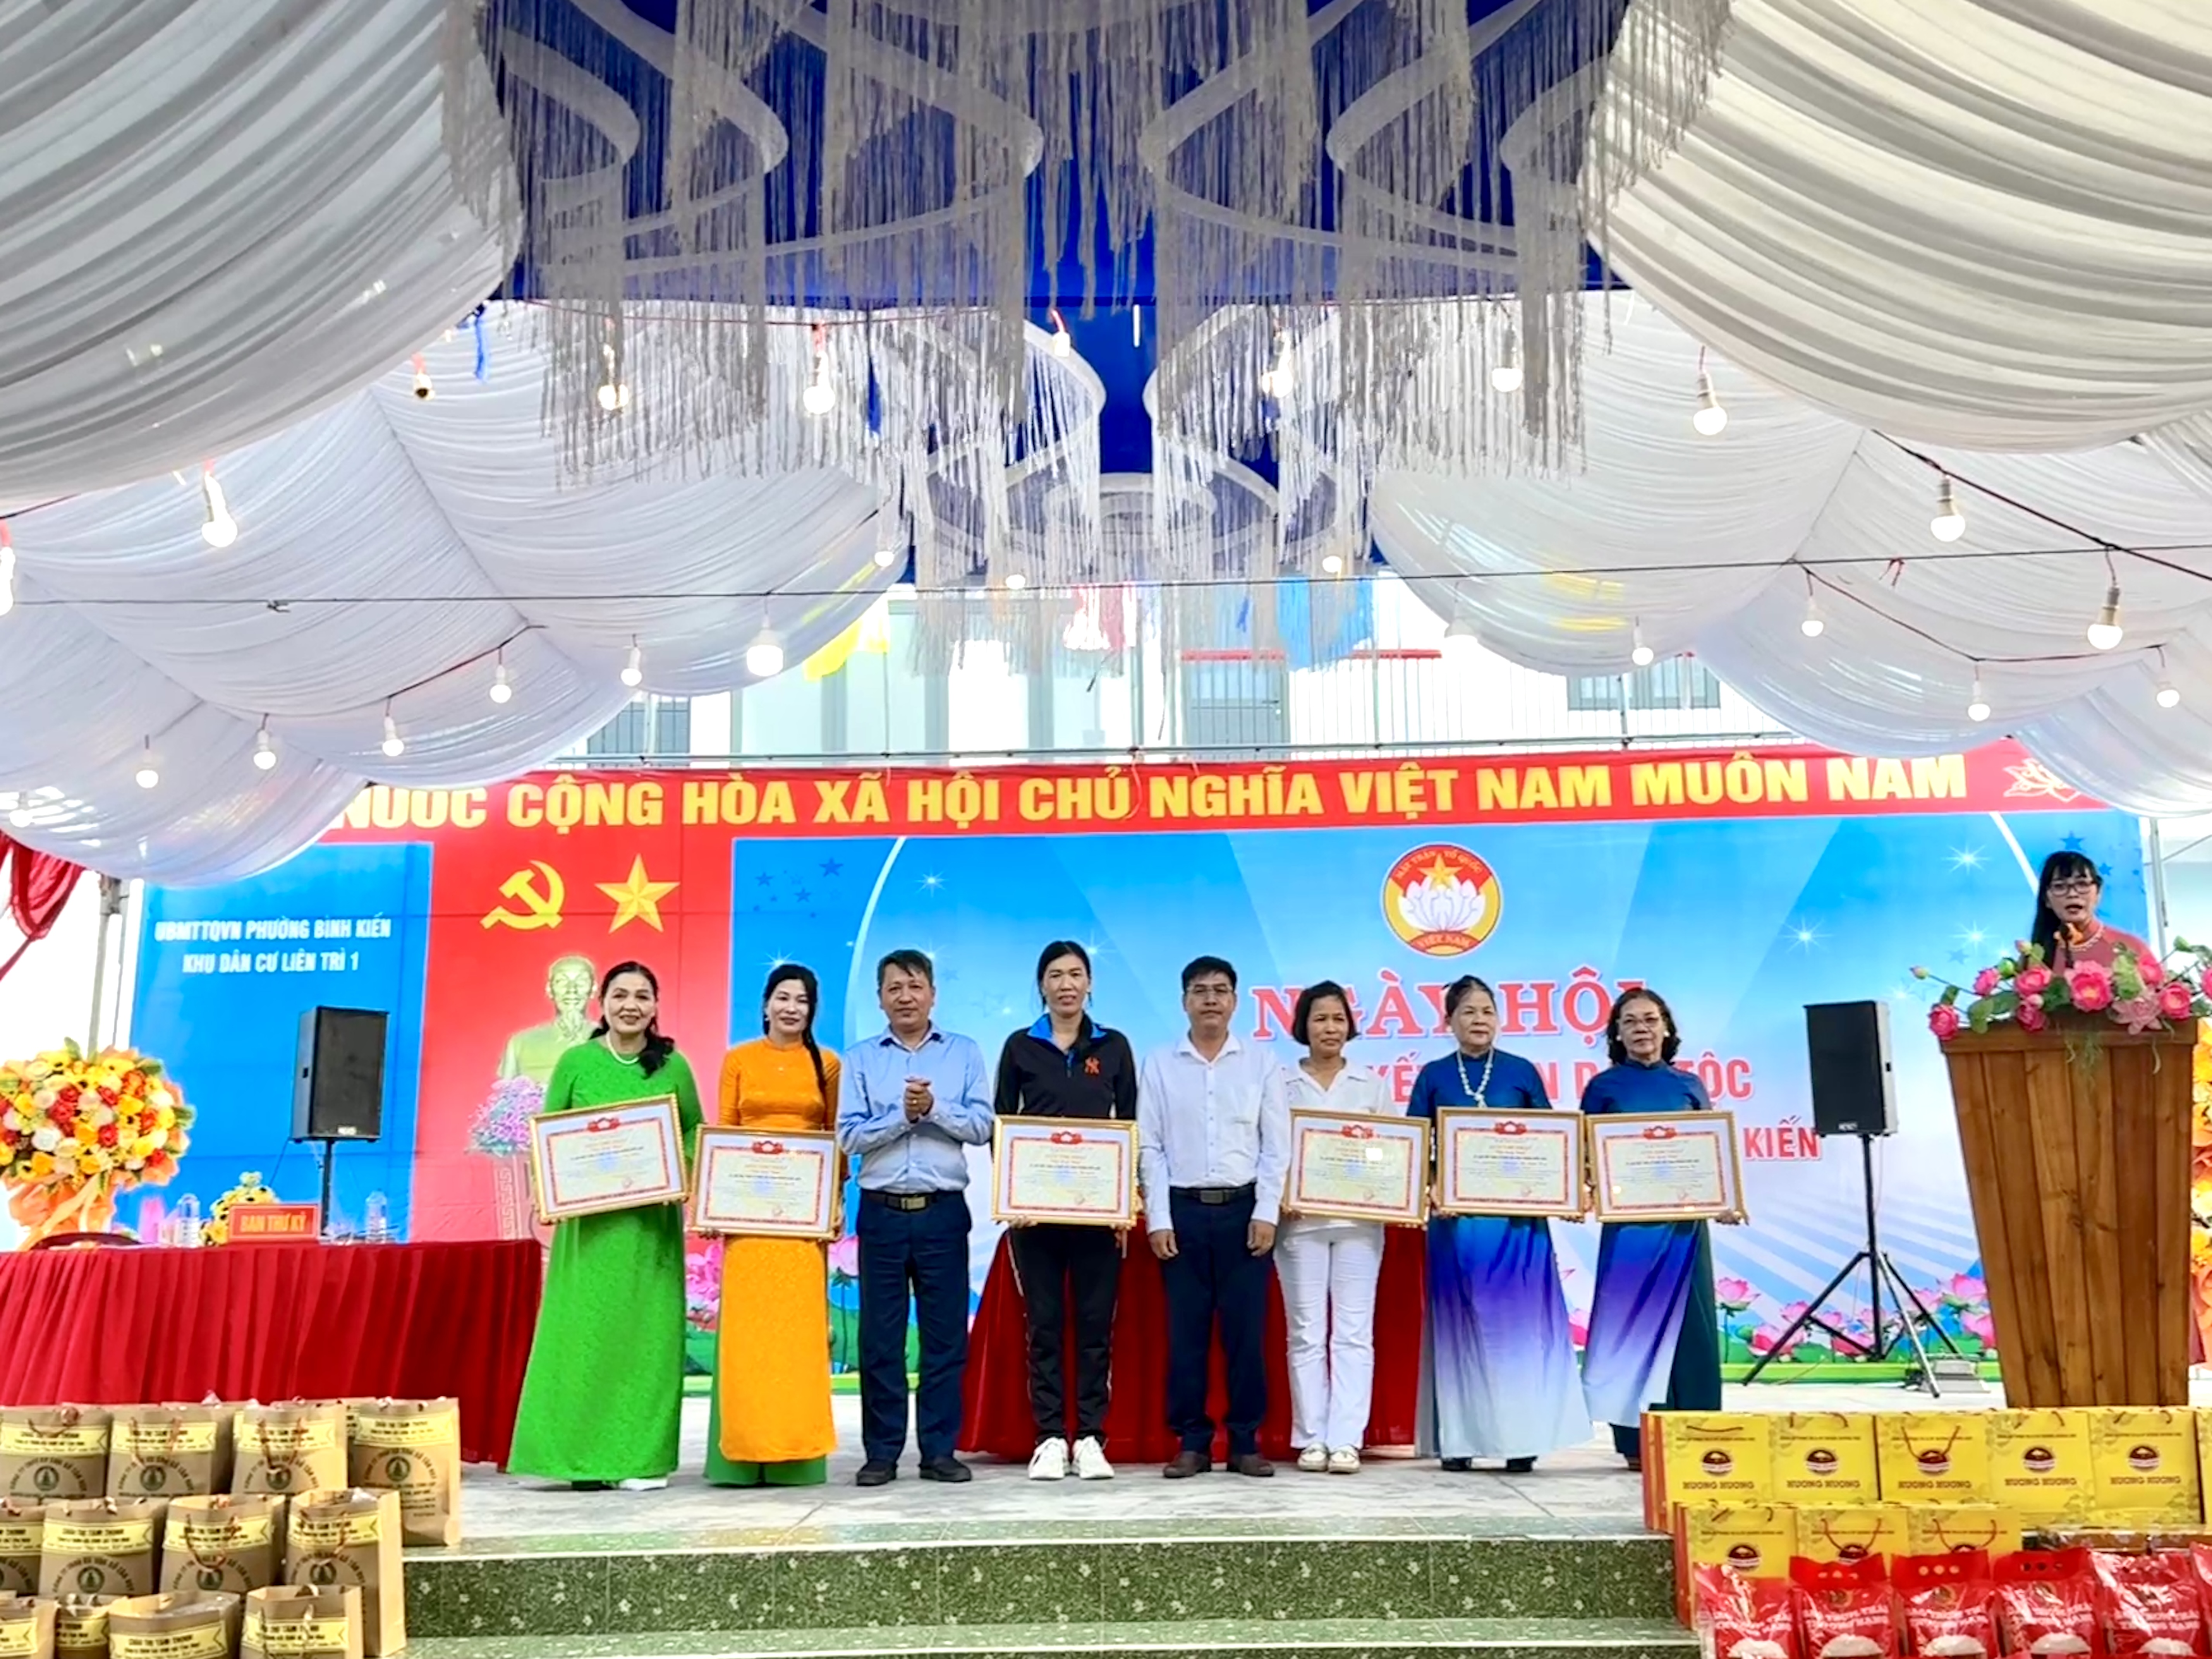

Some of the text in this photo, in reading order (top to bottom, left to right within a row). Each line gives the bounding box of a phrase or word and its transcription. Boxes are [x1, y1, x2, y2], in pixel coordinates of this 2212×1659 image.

[507, 773, 663, 834] CỘNG
[682, 771, 796, 825] HÒA
[814, 772, 890, 824] XÃ
[907, 770, 999, 829] HỘI
[1018, 766, 1131, 820] CHỦ
[1150, 765, 1324, 818] NGHĨA
[1338, 760, 1459, 819] VIỆT
[1478, 764, 1612, 811] NAM
[1630, 750, 1807, 805] MUÔN
[1826, 754, 1968, 801] NAM
[155, 920, 242, 942] UBMTTQVN
[245, 915, 310, 940] PHƯỜNG
[355, 912, 392, 938] KIẾN
[182, 947, 359, 974] KHU DÂN CƯ LIÊN TRÌ 1
[1252, 965, 1644, 1046] NÀY HỘ
[1743, 1115, 1819, 1159] KIẾN
[240, 1214, 265, 1233] BAN
[268, 1212, 290, 1232] THƯ
